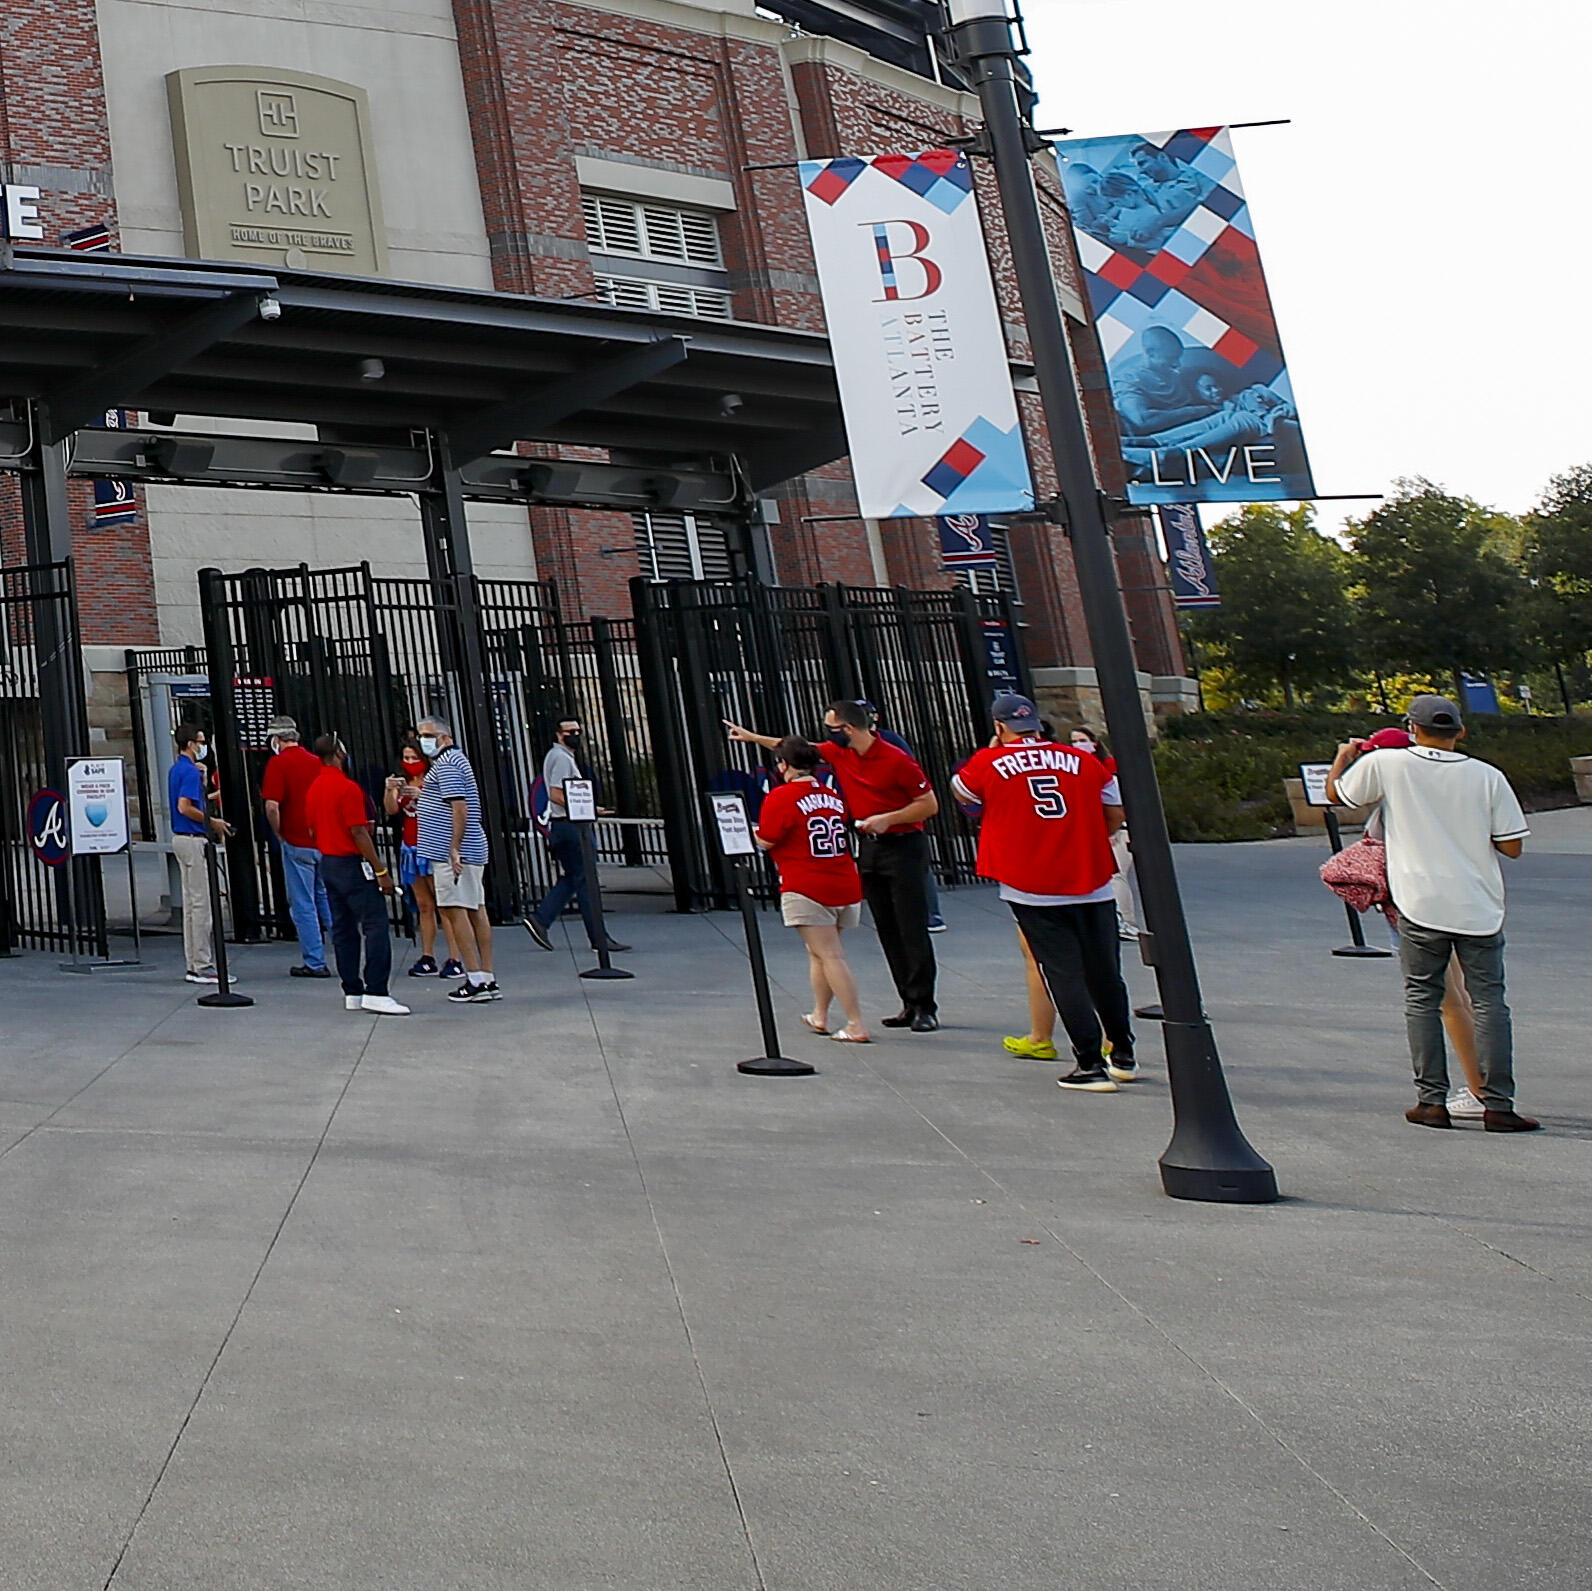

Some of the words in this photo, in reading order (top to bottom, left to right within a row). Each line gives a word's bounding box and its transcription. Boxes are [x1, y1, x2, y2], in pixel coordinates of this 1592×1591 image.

[224, 143, 340, 181] TRUIST
[245, 183, 332, 218] PARK
[231, 228, 265, 244] HOME
[268, 231, 282, 244] OF
[287, 233, 309, 246] THE
[312, 235, 353, 250] BRAVES
[857, 220, 942, 303] B
[928, 310, 954, 361] THE
[880, 314, 918, 436] ATLANTA
[904, 313, 944, 434] BATTERY
[992, 749, 1081, 779] FREEMAN
[796, 793, 845, 816] MARKAKIS
[1027, 775, 1067, 819] 5
[807, 815, 847, 858] 22
